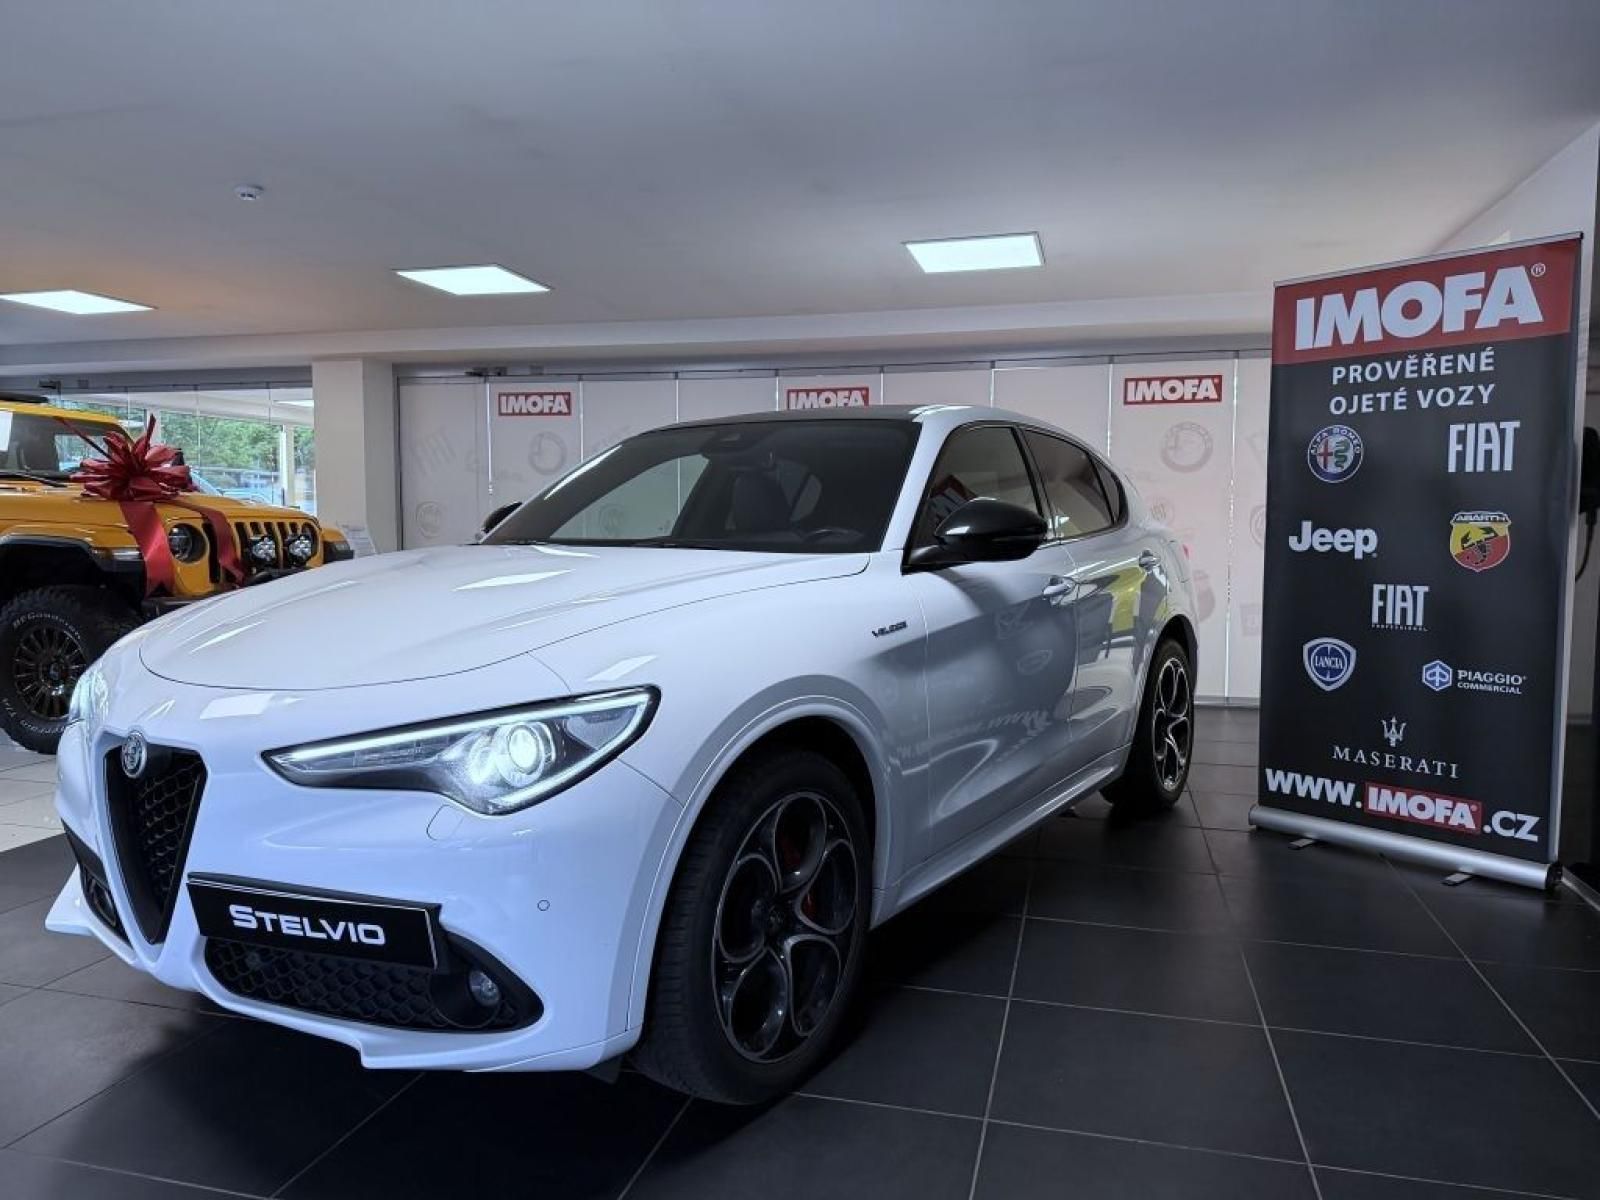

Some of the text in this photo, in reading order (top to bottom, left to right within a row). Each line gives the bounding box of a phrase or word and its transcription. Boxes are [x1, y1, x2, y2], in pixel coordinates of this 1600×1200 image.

[1294, 265, 1543, 350] IMOFA
[1332, 347, 1496, 385] PROVĚŘENÉ
[500, 394, 569, 413] IMOFA
[789, 390, 865, 409] IMOFA
[1127, 378, 1219, 401] IMOFA
[1329, 383, 1495, 415] OJETÉ VOZY
[1447, 421, 1521, 473] FIAT
[1288, 520, 1378, 560] Jeep
[1371, 583, 1430, 626] FIAT
[1313, 655, 1345, 670] LANCIA
[1457, 669, 1523, 686] PIAGGIO
[1457, 681, 1522, 695] COMMERCIAL
[1332, 745, 1459, 779] MASERATI
[228, 904, 387, 947] STELVIO
